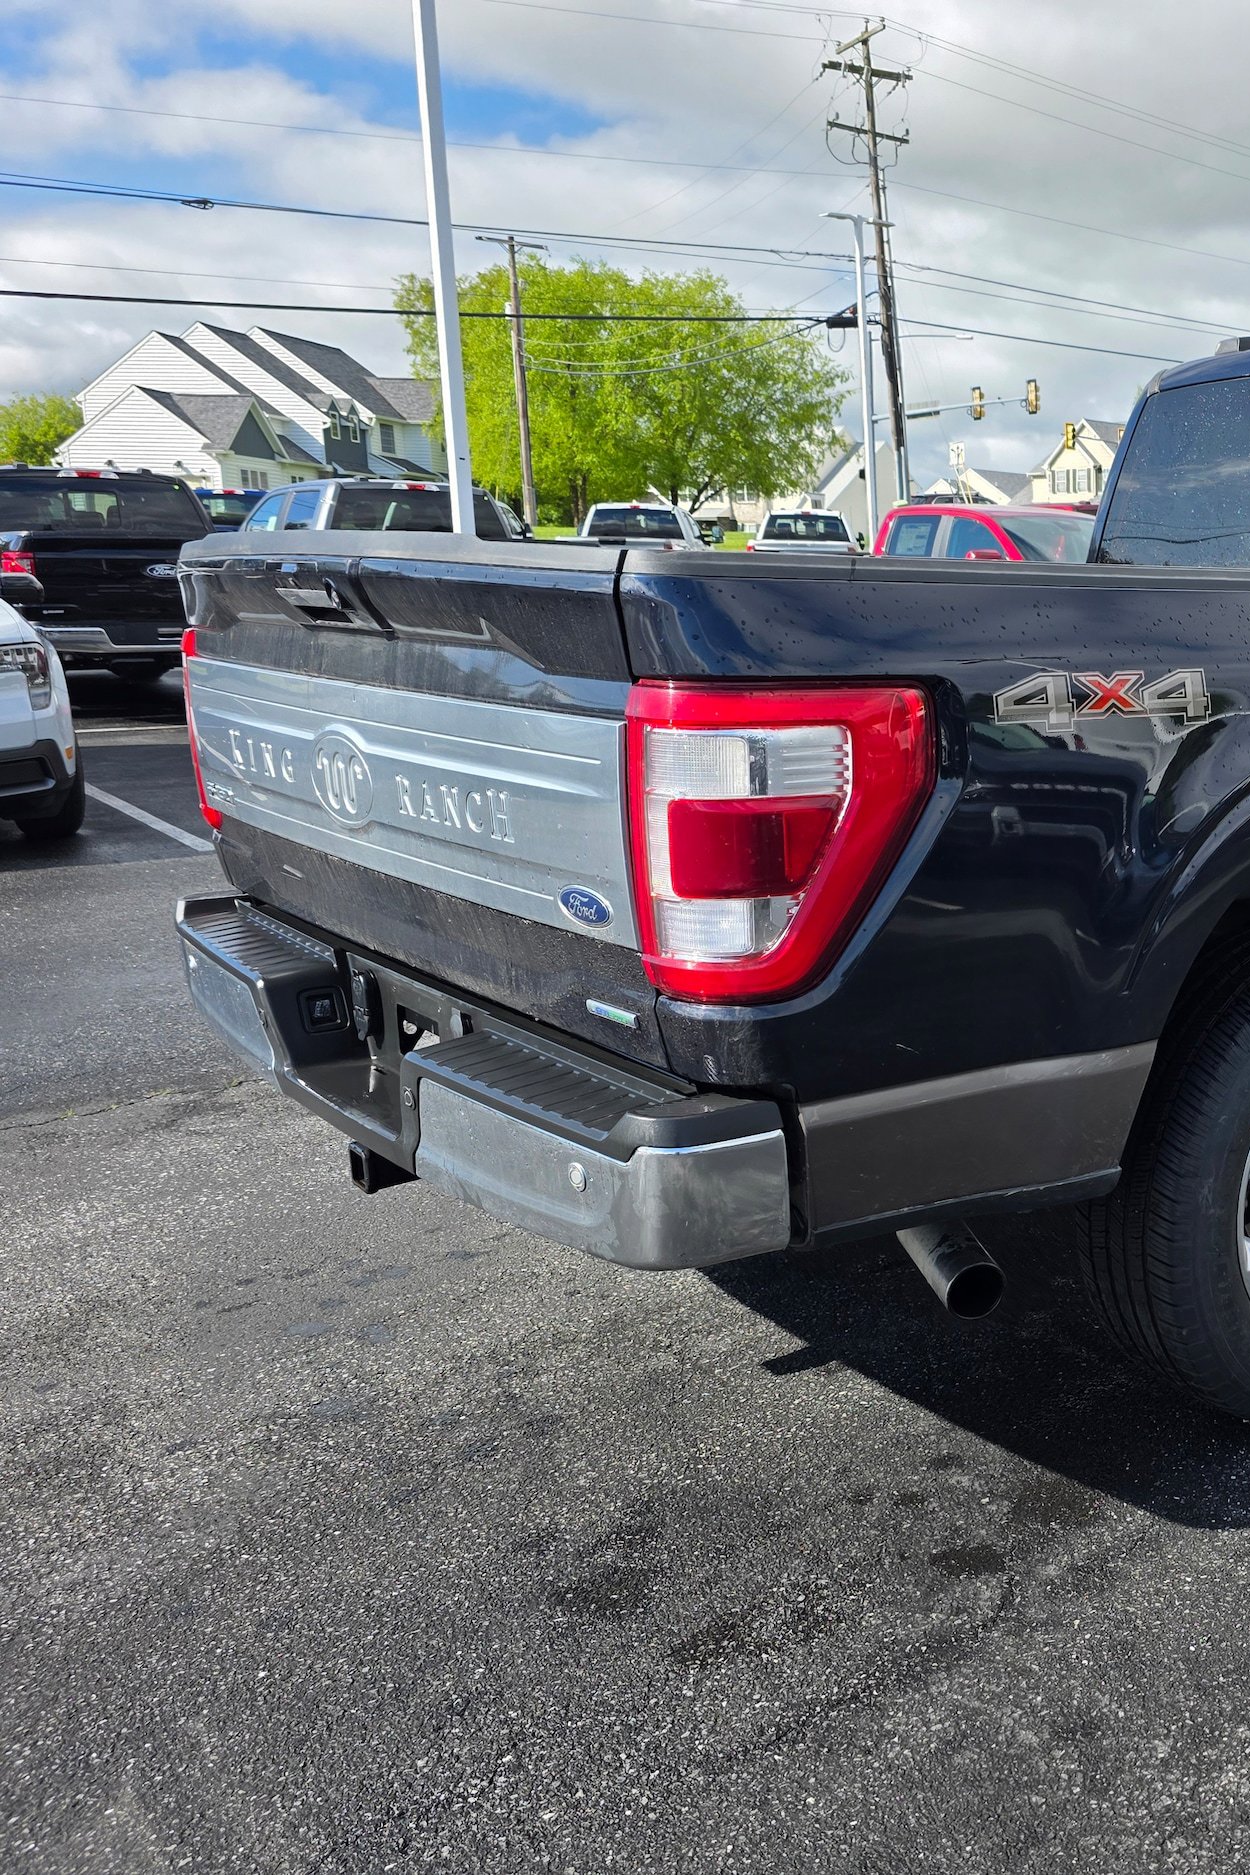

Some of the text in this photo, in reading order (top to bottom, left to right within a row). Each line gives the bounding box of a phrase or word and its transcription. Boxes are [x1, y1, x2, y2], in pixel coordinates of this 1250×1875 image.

[153, 565, 177, 576] Ford
[228, 728, 516, 844] KING RANCH
[568, 893, 598, 920] Ford
